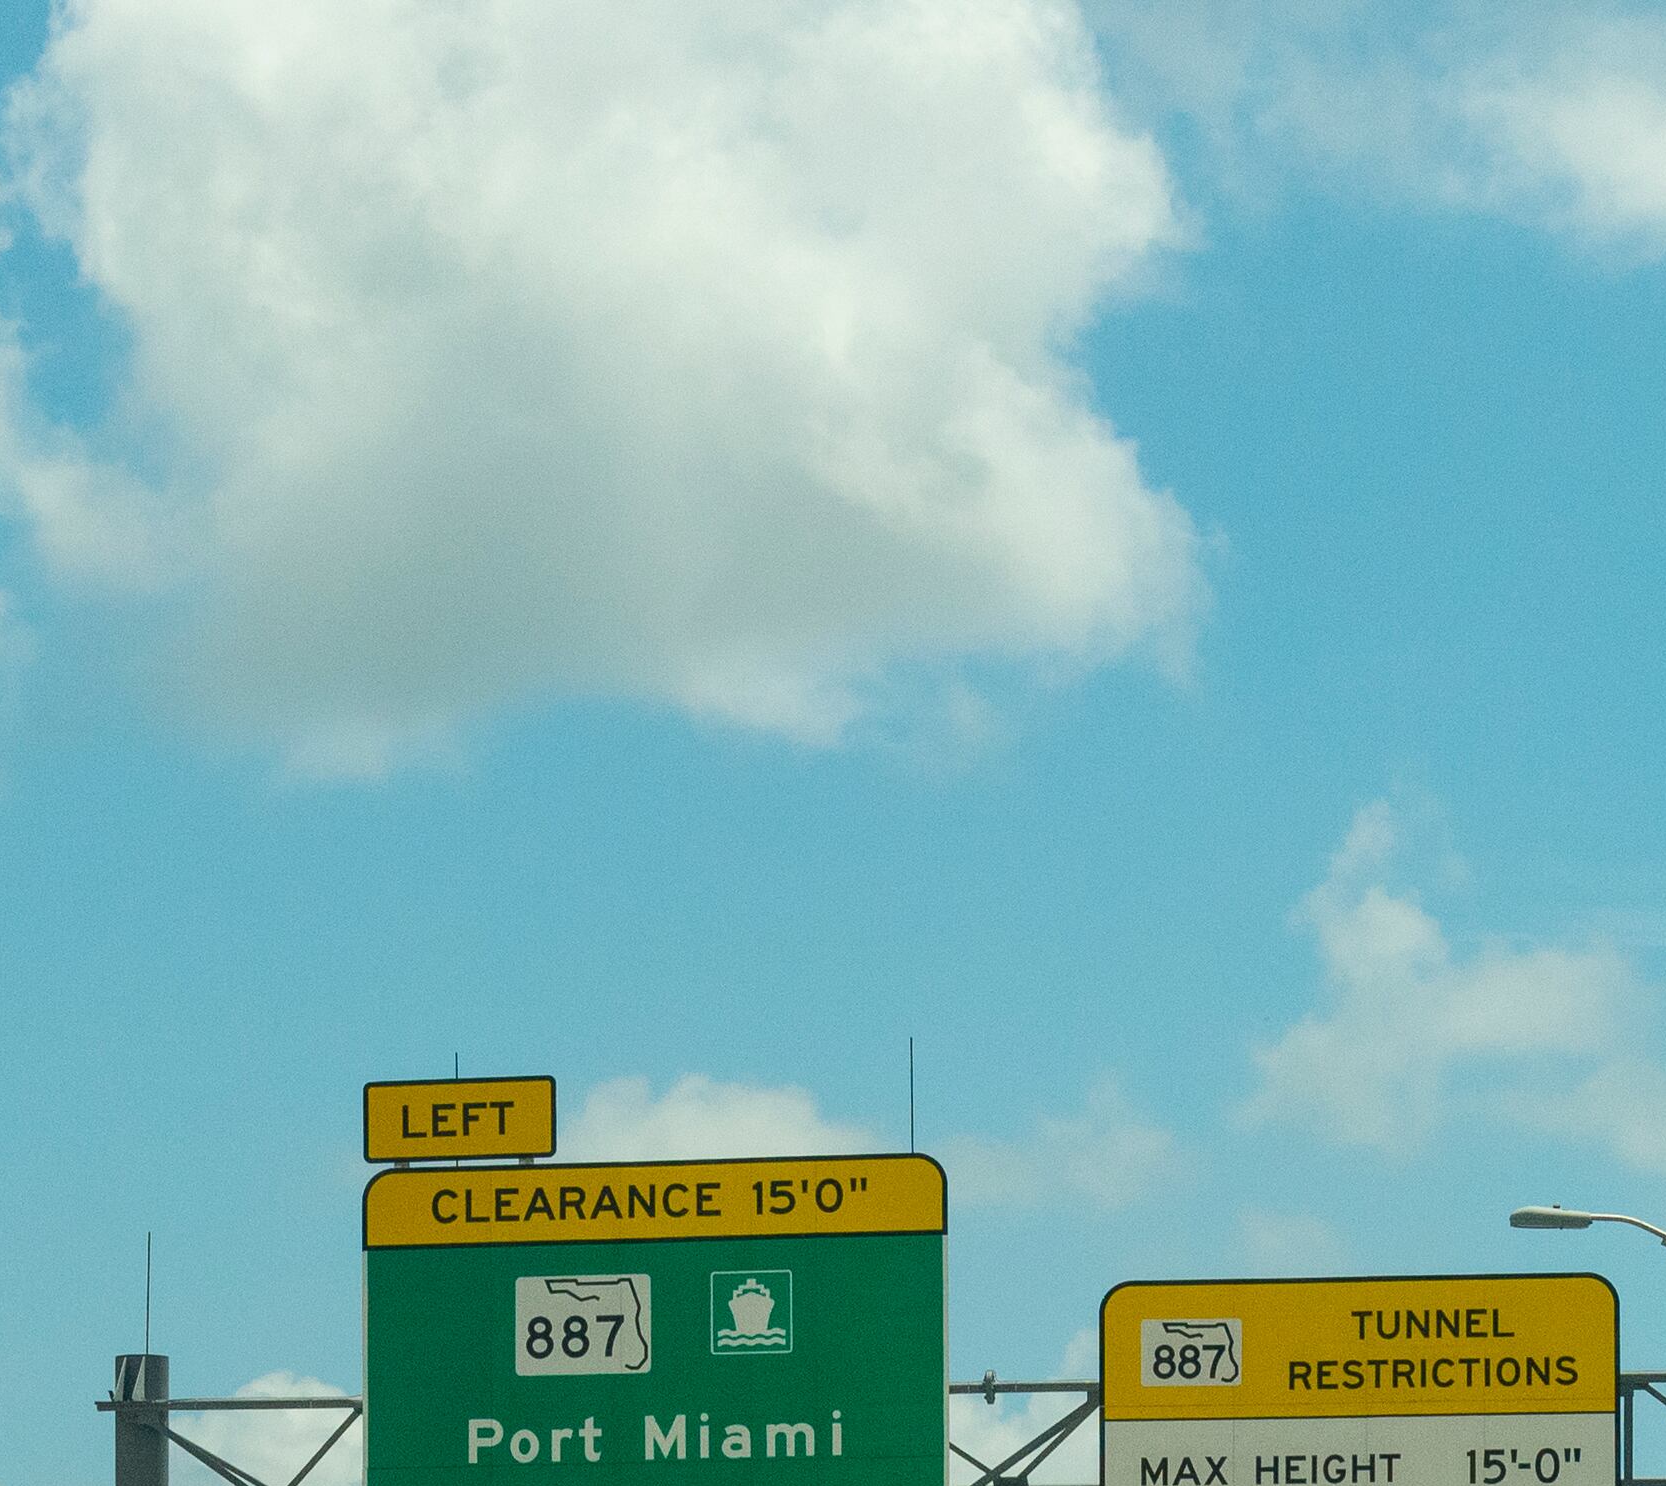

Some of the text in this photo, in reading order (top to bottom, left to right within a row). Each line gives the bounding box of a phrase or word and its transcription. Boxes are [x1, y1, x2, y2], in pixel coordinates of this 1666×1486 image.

[401, 1101, 515, 1139] LEFT
[431, 1177, 869, 1225] CLEARANCE 15'0"
[524, 1314, 626, 1360] 887
[1350, 1308, 1515, 1341] TUNNEL
[1152, 1344, 1225, 1380] 887
[1288, 1355, 1579, 1391] RESTRICTIONS
[466, 1409, 843, 1464] Port Miami
[1139, 1447, 1582, 1486] MAX HEIGHT 15'-0"
